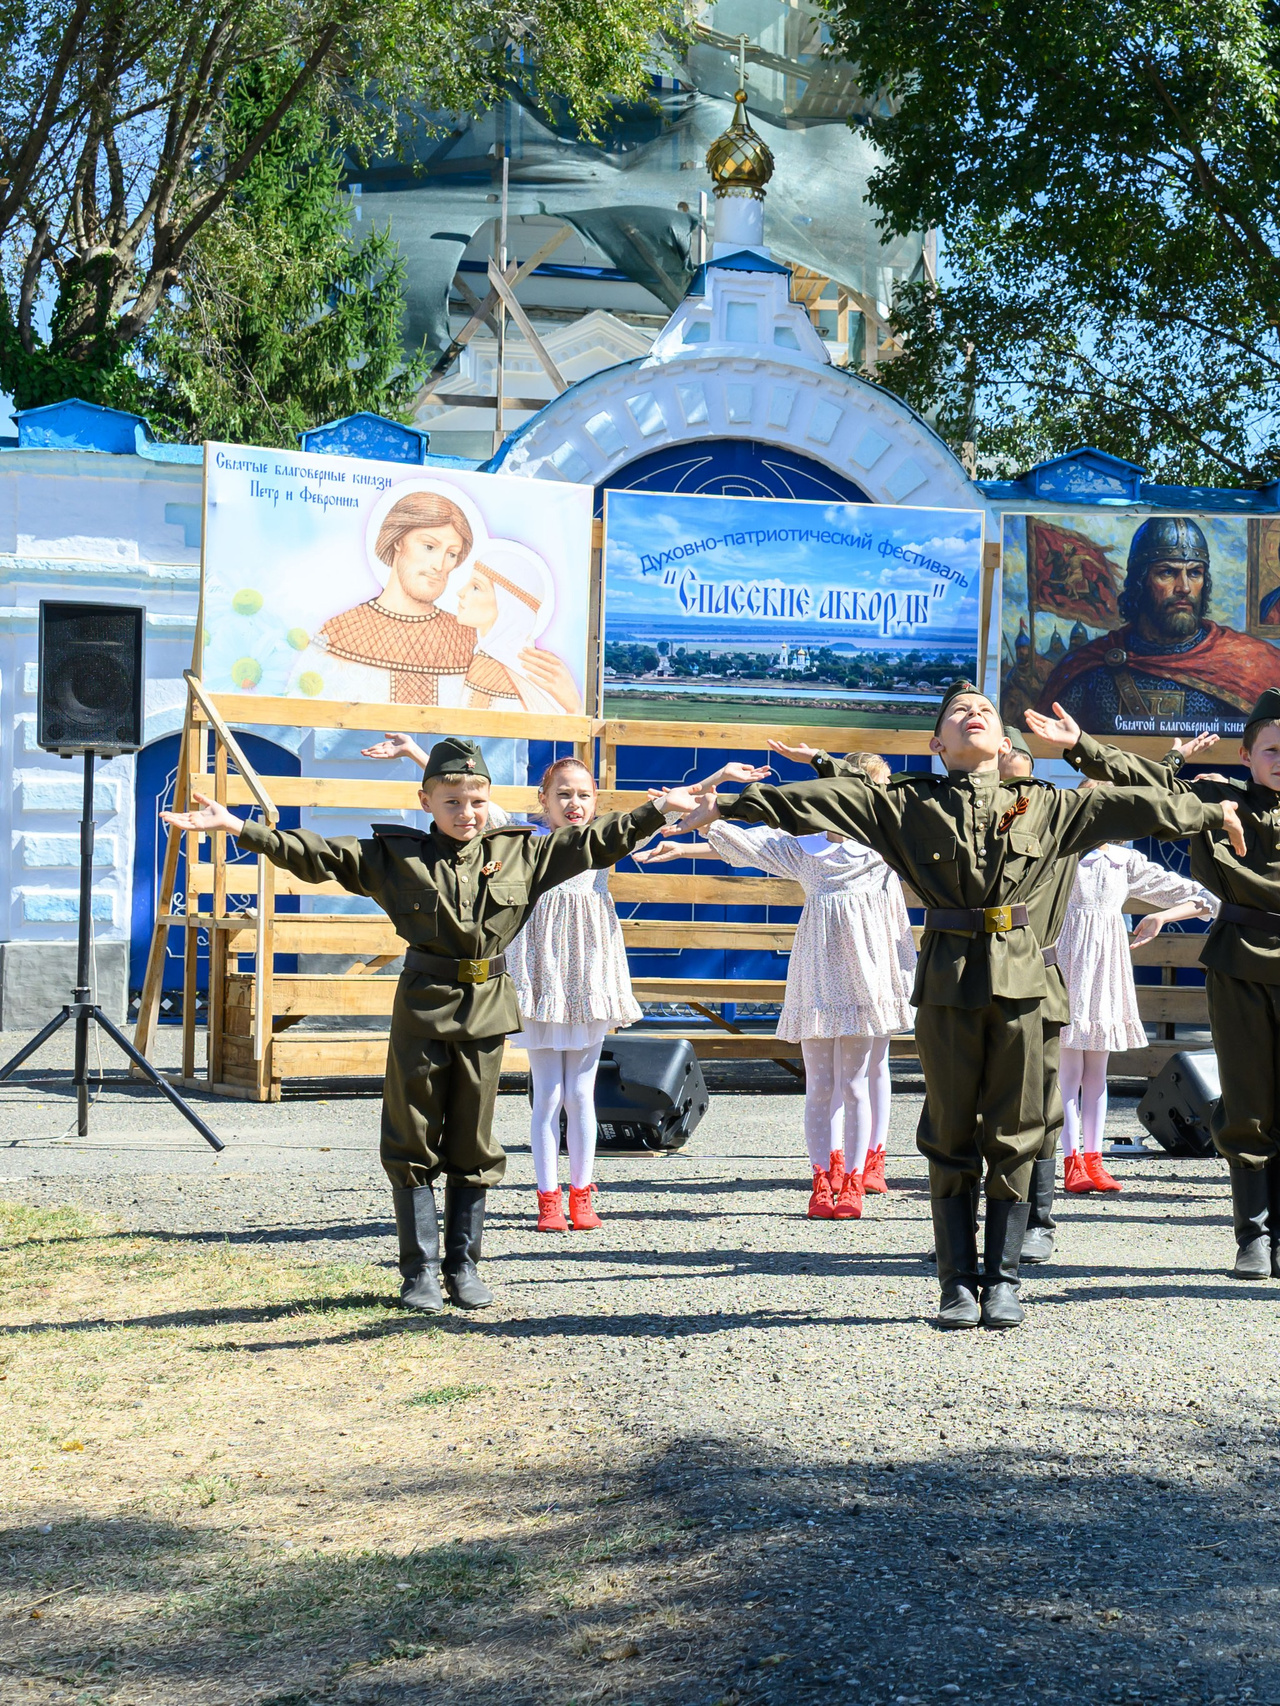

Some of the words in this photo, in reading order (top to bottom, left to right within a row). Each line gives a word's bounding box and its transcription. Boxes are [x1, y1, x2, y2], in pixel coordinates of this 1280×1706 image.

[216, 451, 268, 474] Святые
[274, 464, 346, 488] благоверные
[250, 479, 279, 508] Петр
[285, 490, 293, 501] и
[299, 485, 359, 513] Феврония
[640, 528, 872, 576] Духовно-патриотический
[877, 539, 969, 589] фестиваль
[663, 568, 810, 618] "Спасские
[819, 583, 945, 635] аккорды"
[1114, 714, 1155, 731] Святой
[1159, 717, 1220, 738] благоверный
[1224, 722, 1247, 733] кня
